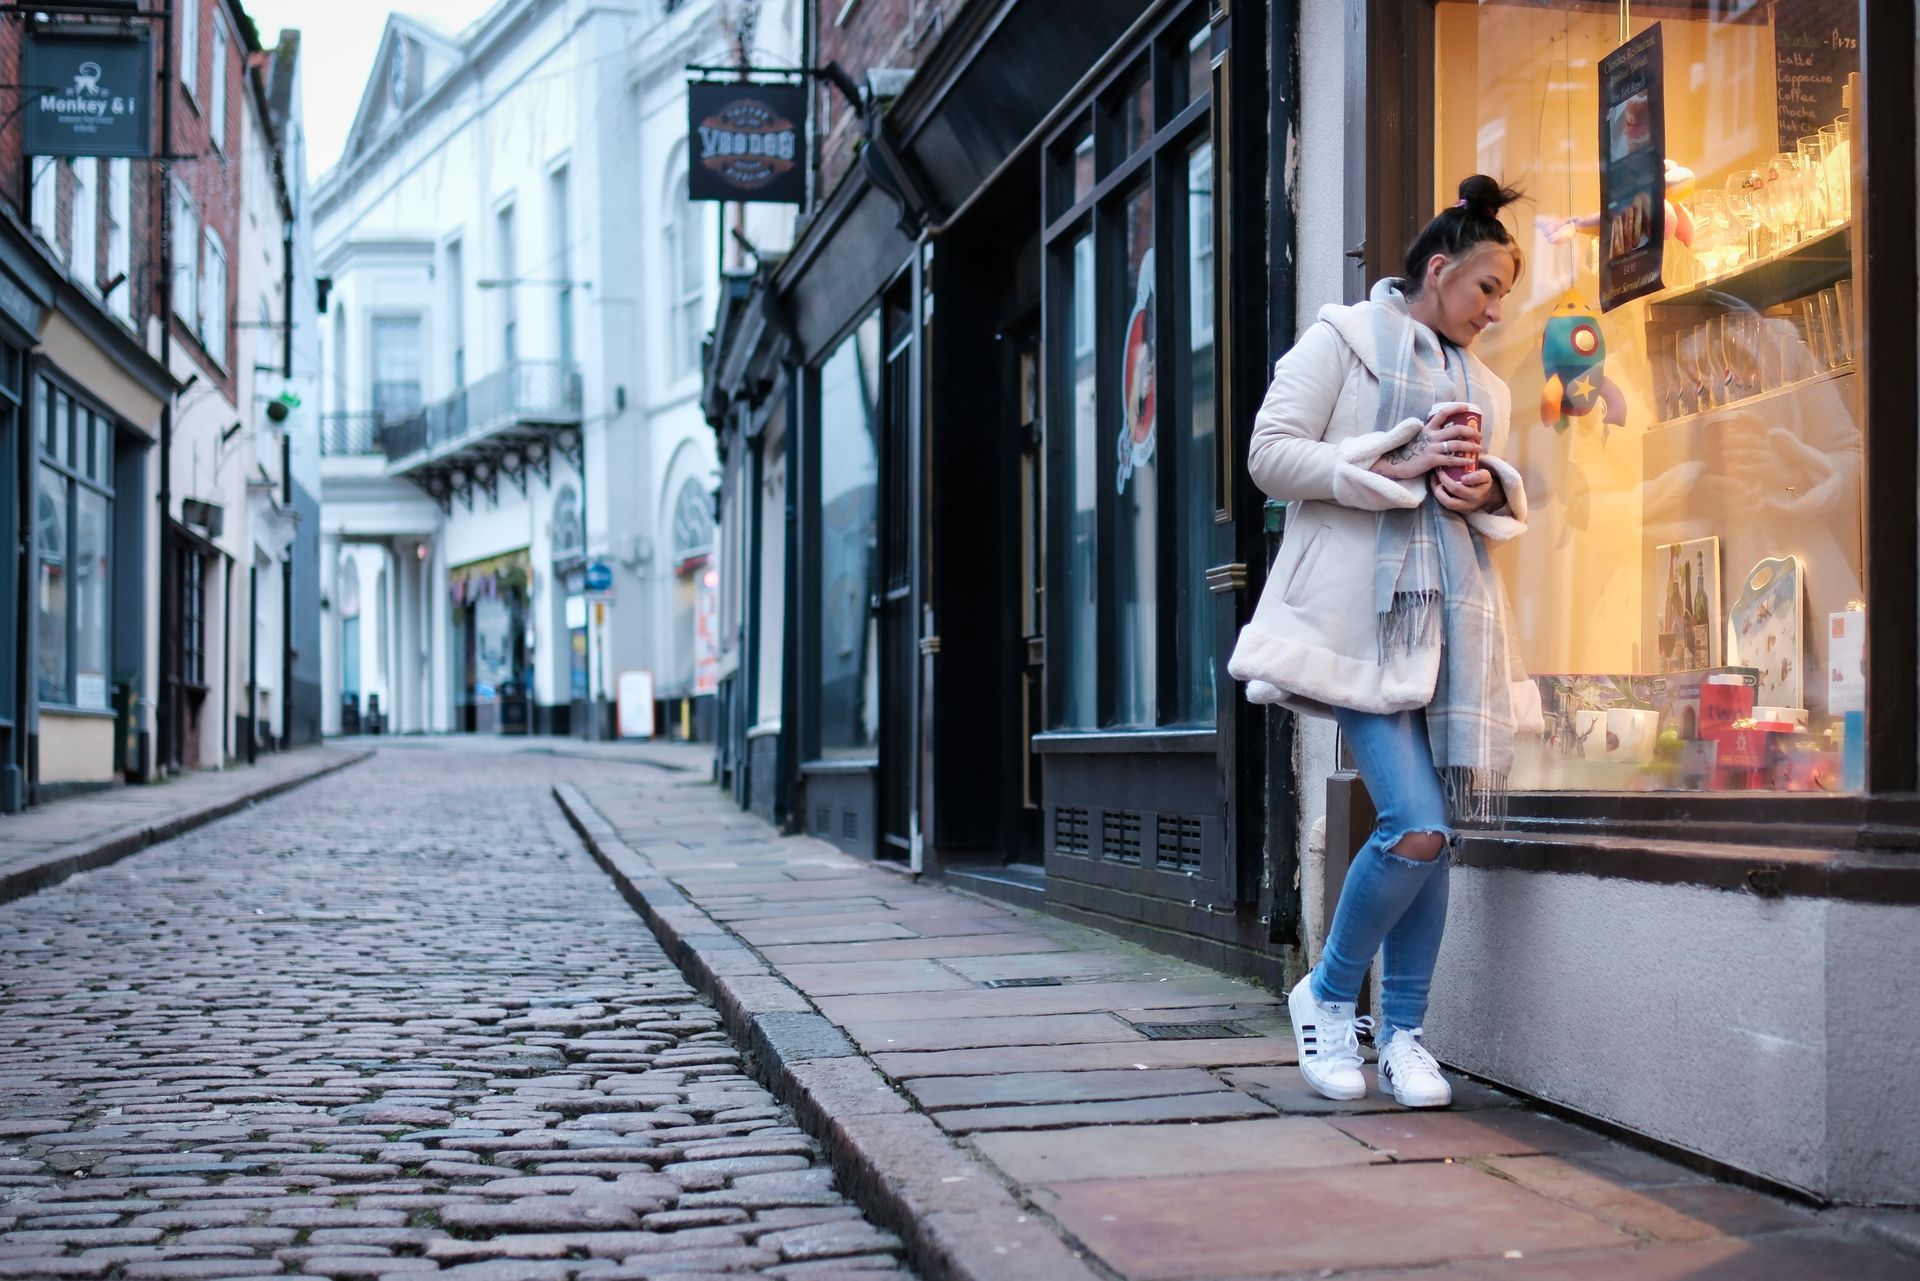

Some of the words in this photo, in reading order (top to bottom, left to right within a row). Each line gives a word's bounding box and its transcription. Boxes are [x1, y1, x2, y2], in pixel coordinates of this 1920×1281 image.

[1777, 87, 1817, 103] Coffee
[40, 95, 108, 118] Monkey
[111, 96, 125, 115] &
[1779, 104, 1817, 119] Mocha
[1779, 120, 1799, 131] Hot
